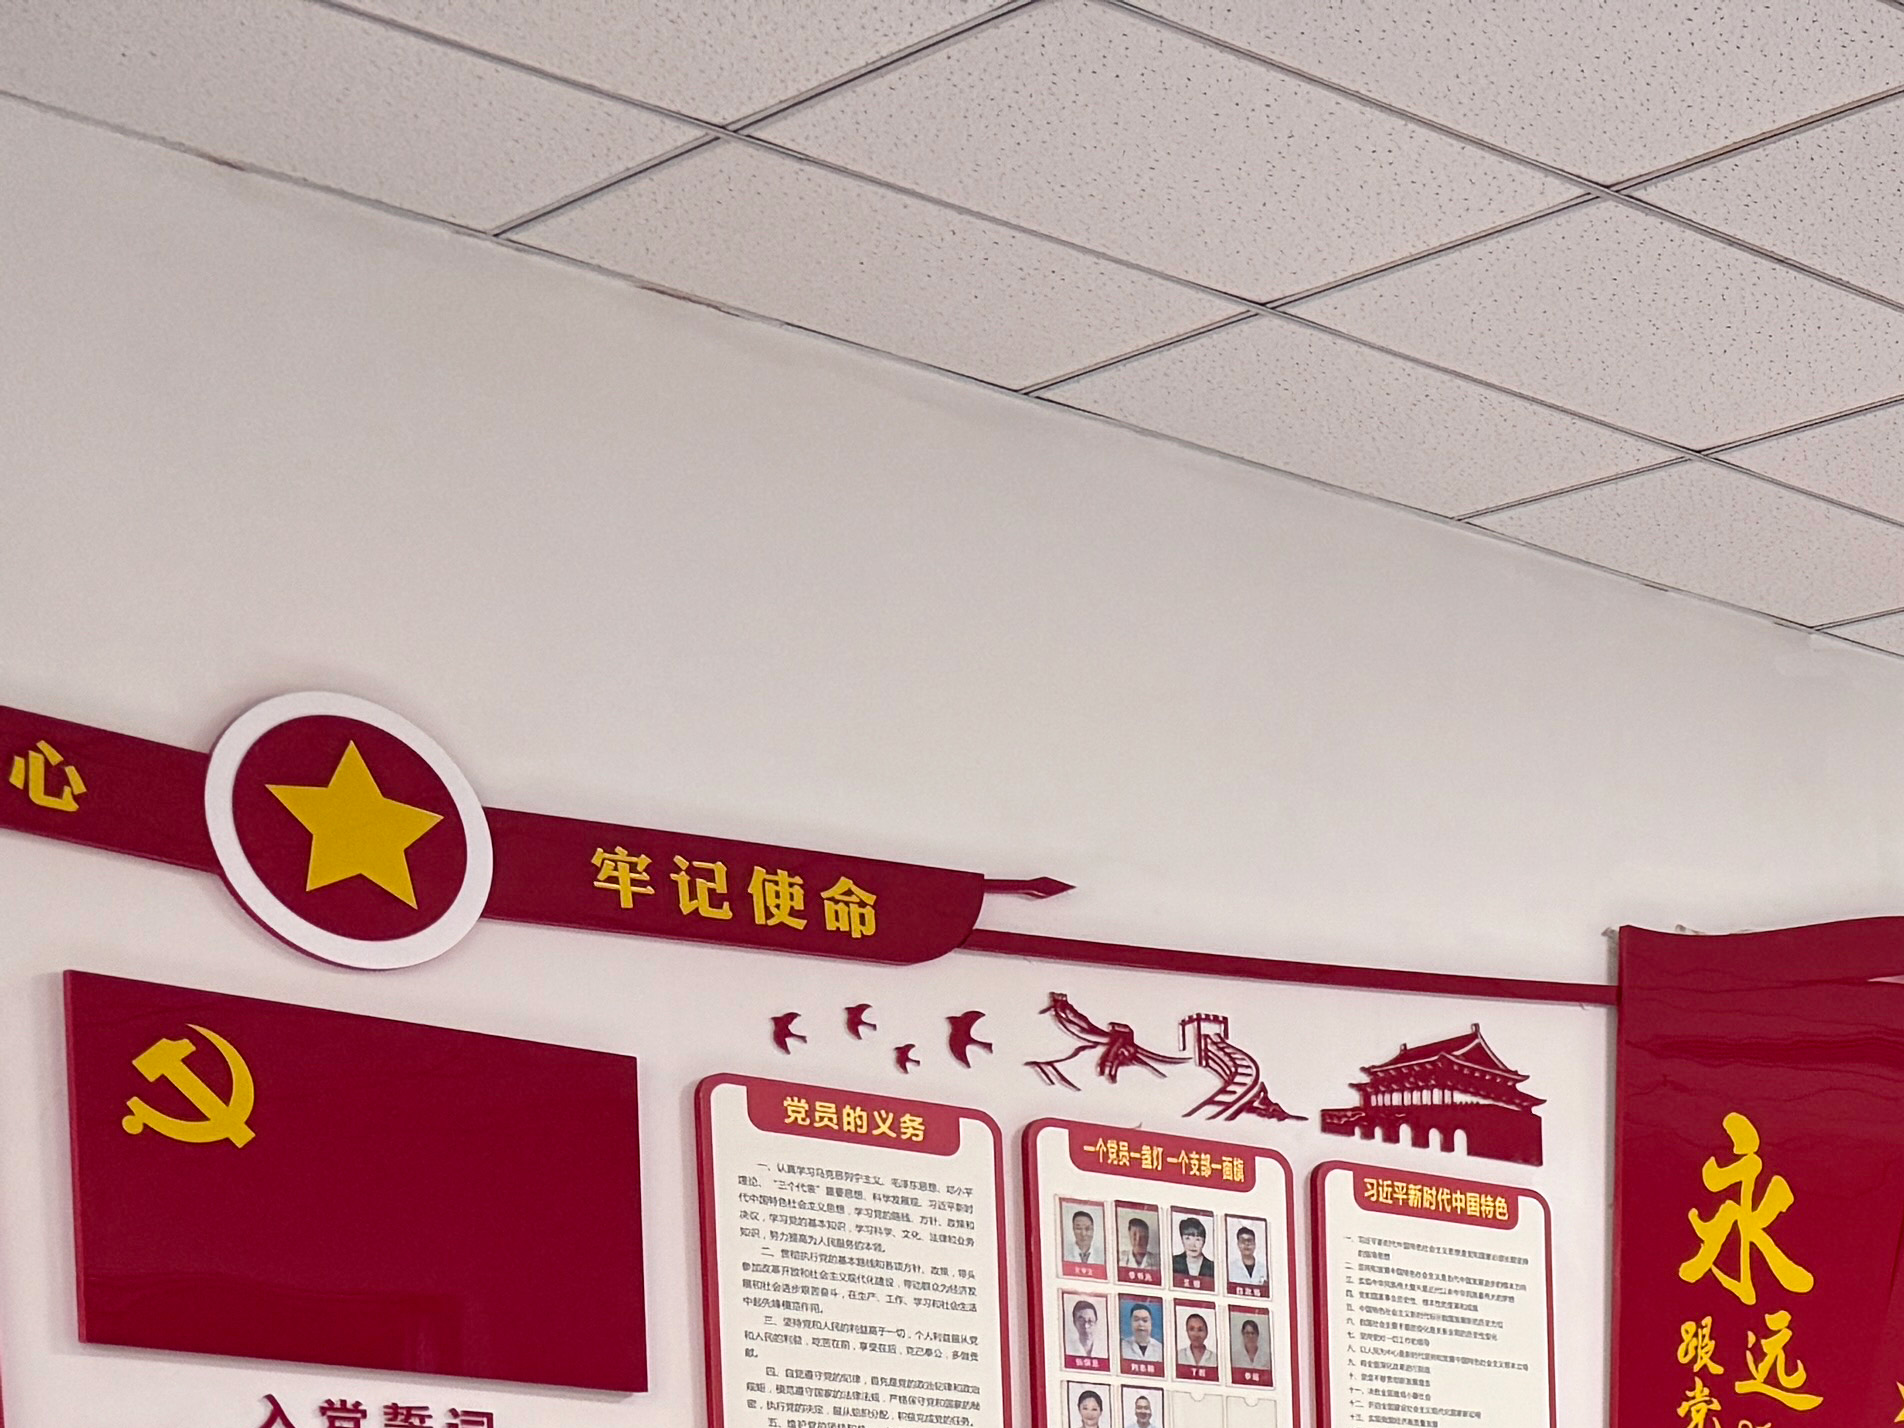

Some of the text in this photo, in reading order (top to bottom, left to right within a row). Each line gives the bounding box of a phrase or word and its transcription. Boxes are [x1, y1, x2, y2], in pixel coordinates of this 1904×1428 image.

[9, 739, 86, 813] 心
[591, 846, 878, 939] 牢记使命
[783, 1096, 926, 1141] 党员的义务
[1083, 1137, 1245, 1183] 一个党员一盏灯 一个支部一面旗
[1363, 1177, 1509, 1221] 习近平新时代中国特色
[1678, 1111, 1824, 1411] 永远
